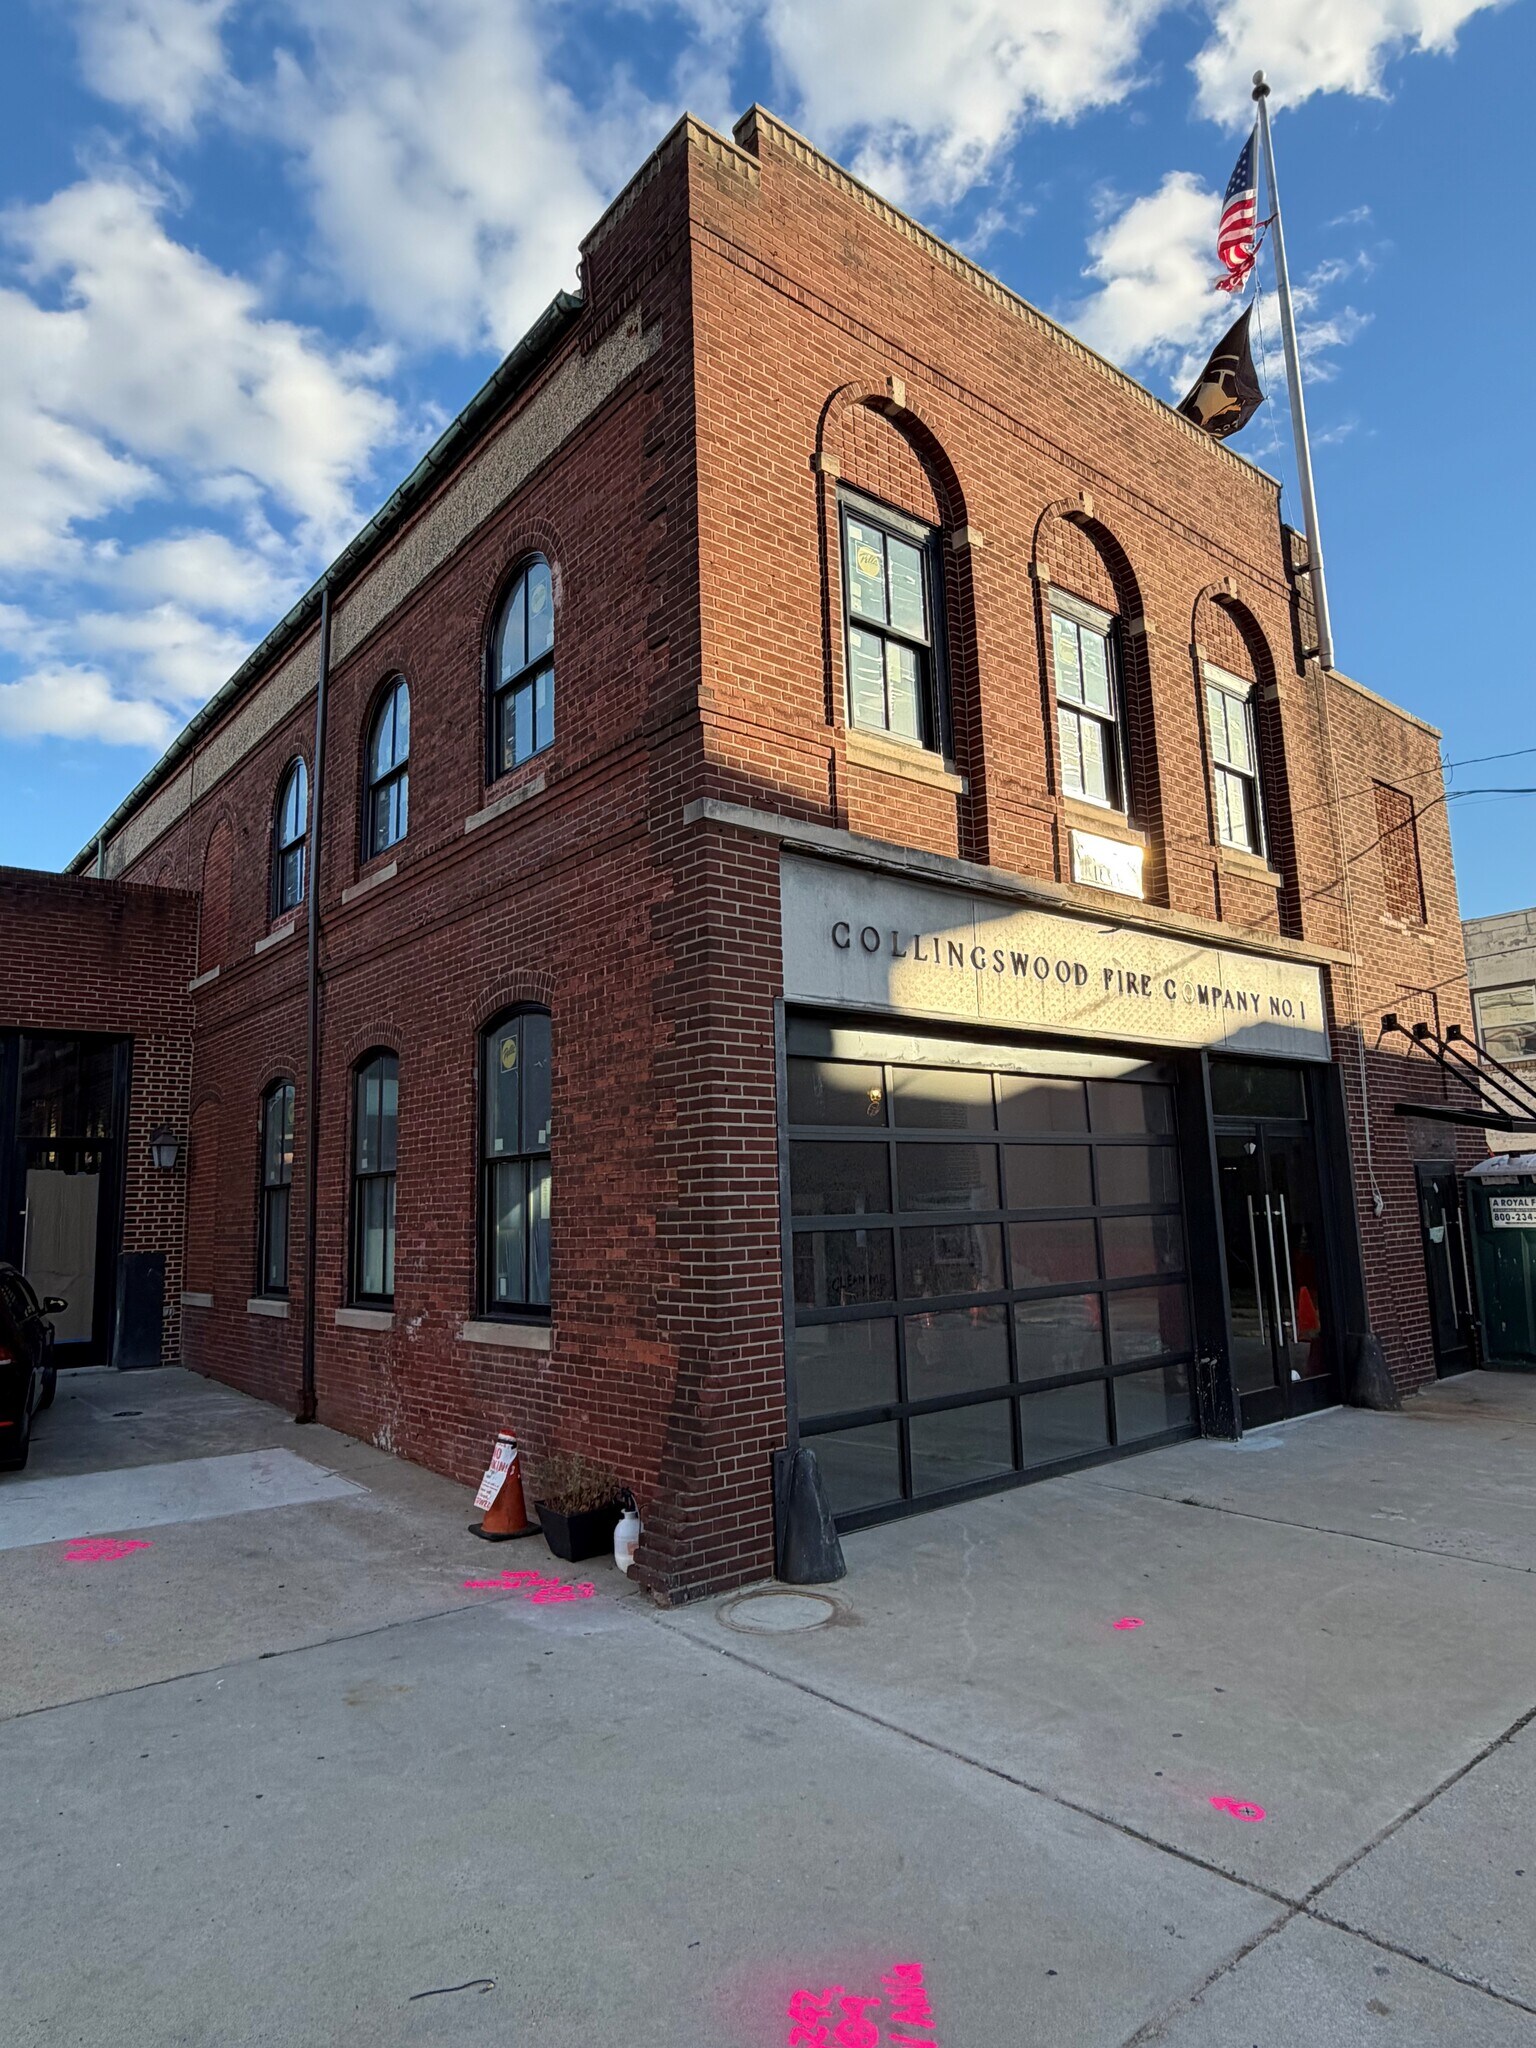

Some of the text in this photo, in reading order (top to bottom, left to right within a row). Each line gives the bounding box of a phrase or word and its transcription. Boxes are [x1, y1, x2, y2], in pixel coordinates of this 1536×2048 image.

[831, 921, 1088, 986] COLLINGSWOOD
[1103, 968, 1152, 997] FIRE
[1269, 996, 1295, 1018] NO.
